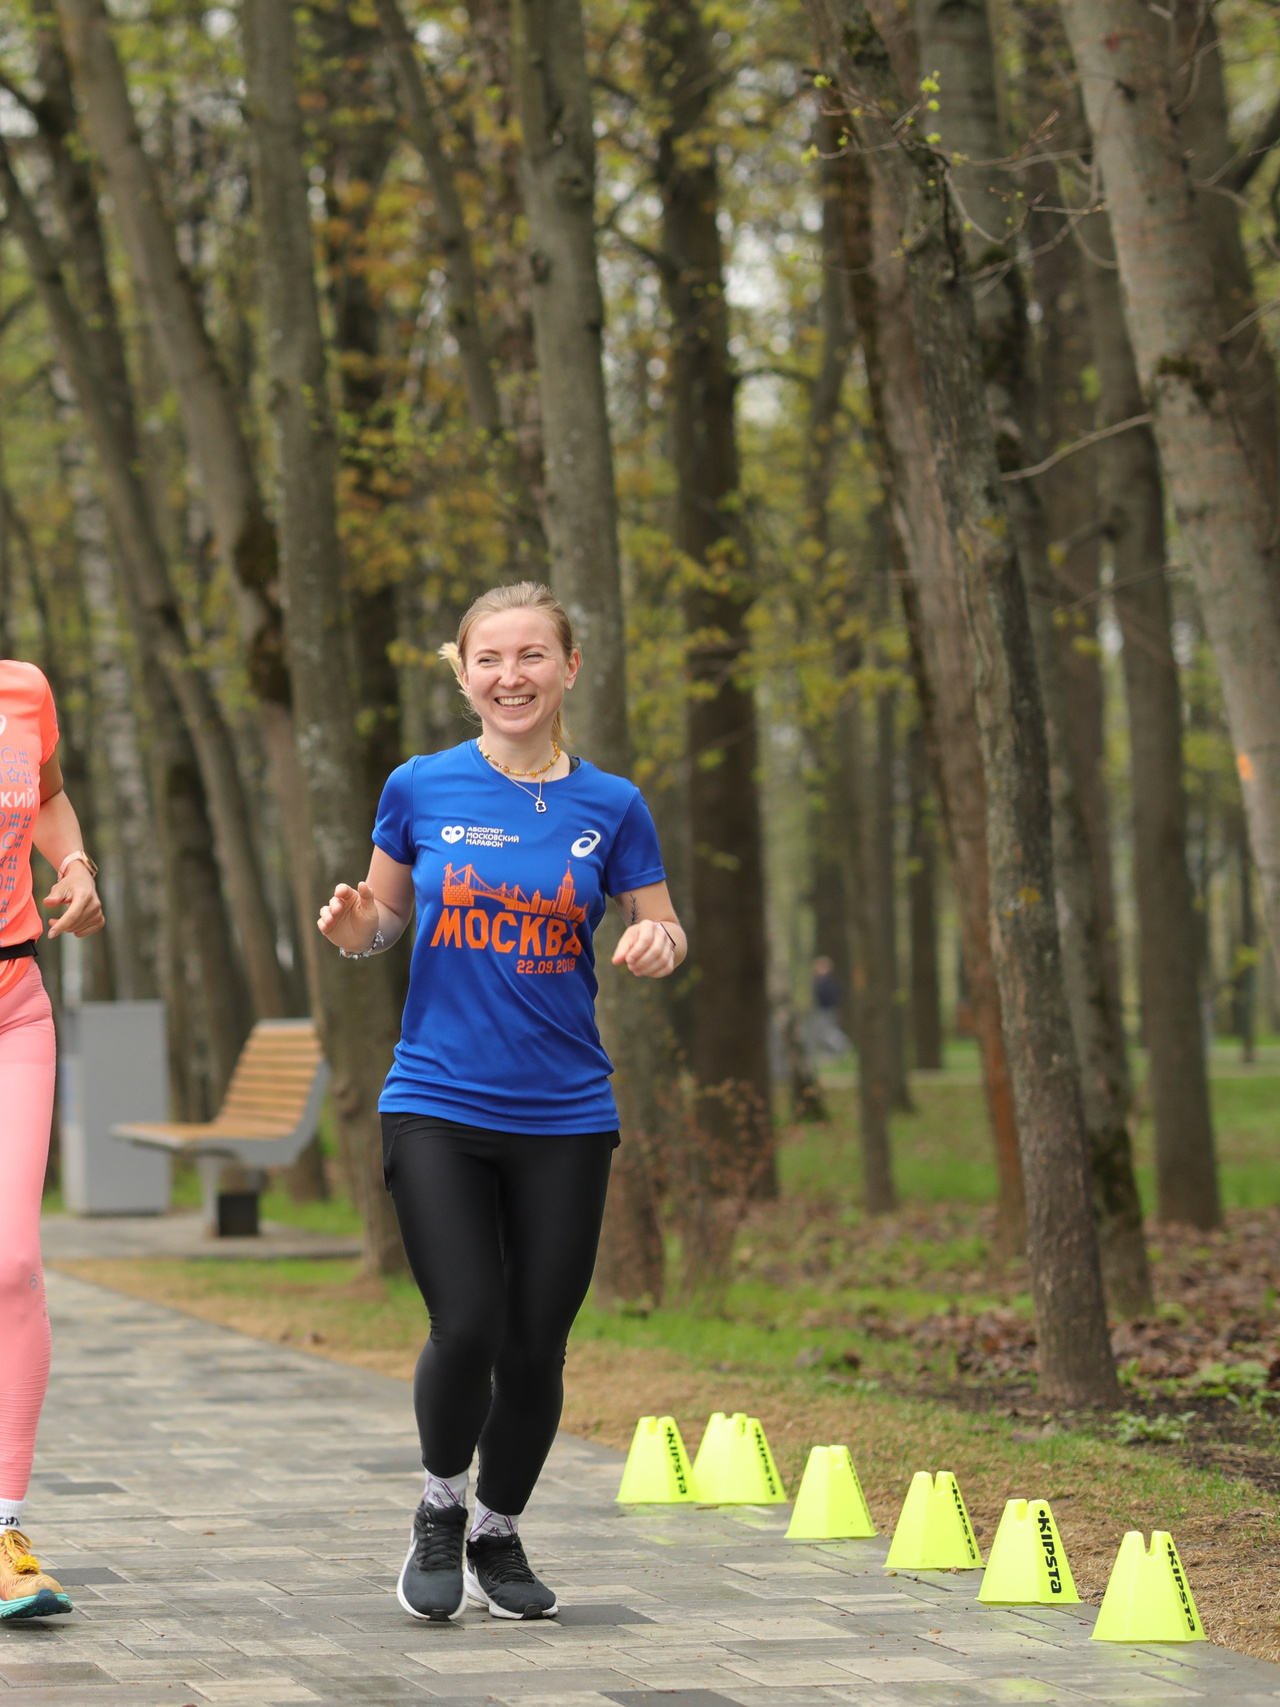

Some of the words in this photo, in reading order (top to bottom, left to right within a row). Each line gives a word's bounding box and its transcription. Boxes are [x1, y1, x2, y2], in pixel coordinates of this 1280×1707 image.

[465, 839, 503, 847] МАРАФОН
[466, 832, 519, 842] МОСКОВСКИЙ
[430, 907, 582, 957] МОСКВА
[516, 959, 576, 974] 22.09.2019
